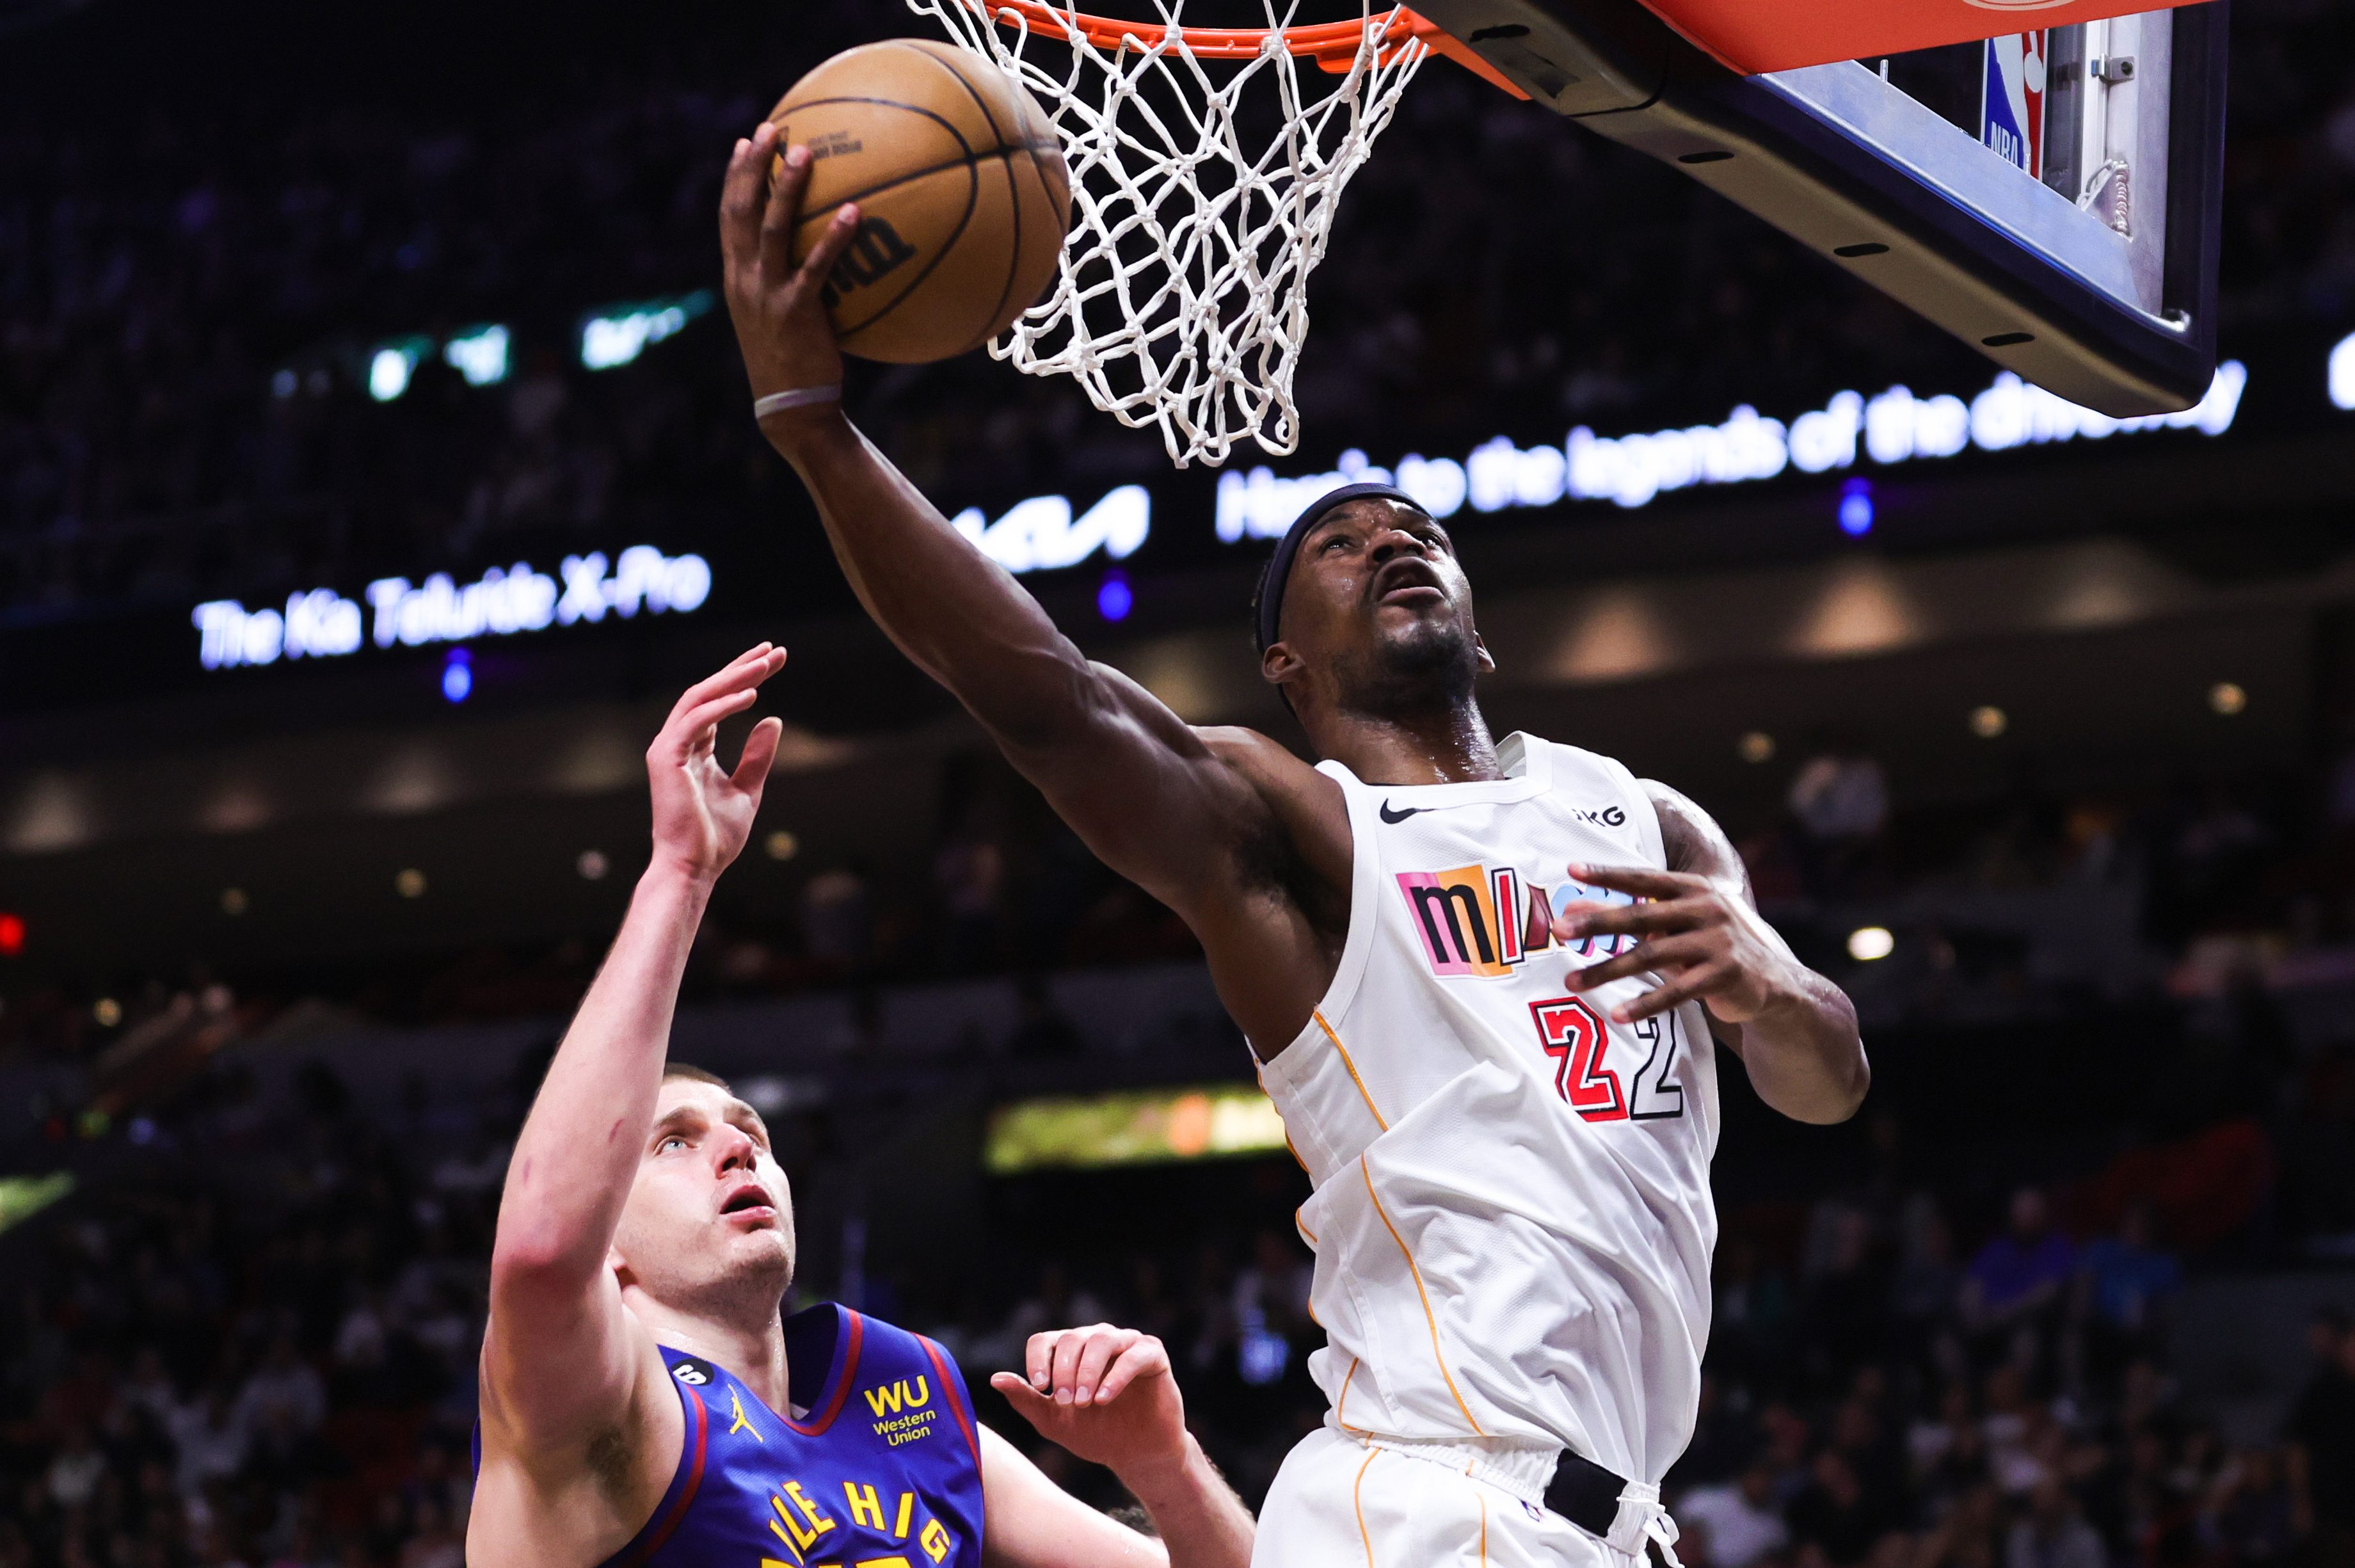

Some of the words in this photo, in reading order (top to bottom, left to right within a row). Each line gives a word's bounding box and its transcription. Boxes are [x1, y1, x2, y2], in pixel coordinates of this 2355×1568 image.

[1990, 120, 2018, 166] NBA
[1397, 453, 1467, 518] to
[1467, 435, 1566, 512] the
[1567, 404, 1787, 508] legends
[1789, 389, 1865, 473] of
[1865, 384, 1971, 464] the
[193, 600, 283, 671] The
[284, 588, 362, 660] Kia
[557, 544, 712, 626] X-Pro
[1528, 996, 1683, 1123] 22
[673, 1364, 707, 1385] 6
[864, 1375, 929, 1418] WU
[873, 1410, 936, 1436] Western
[887, 1426, 931, 1446] Union
